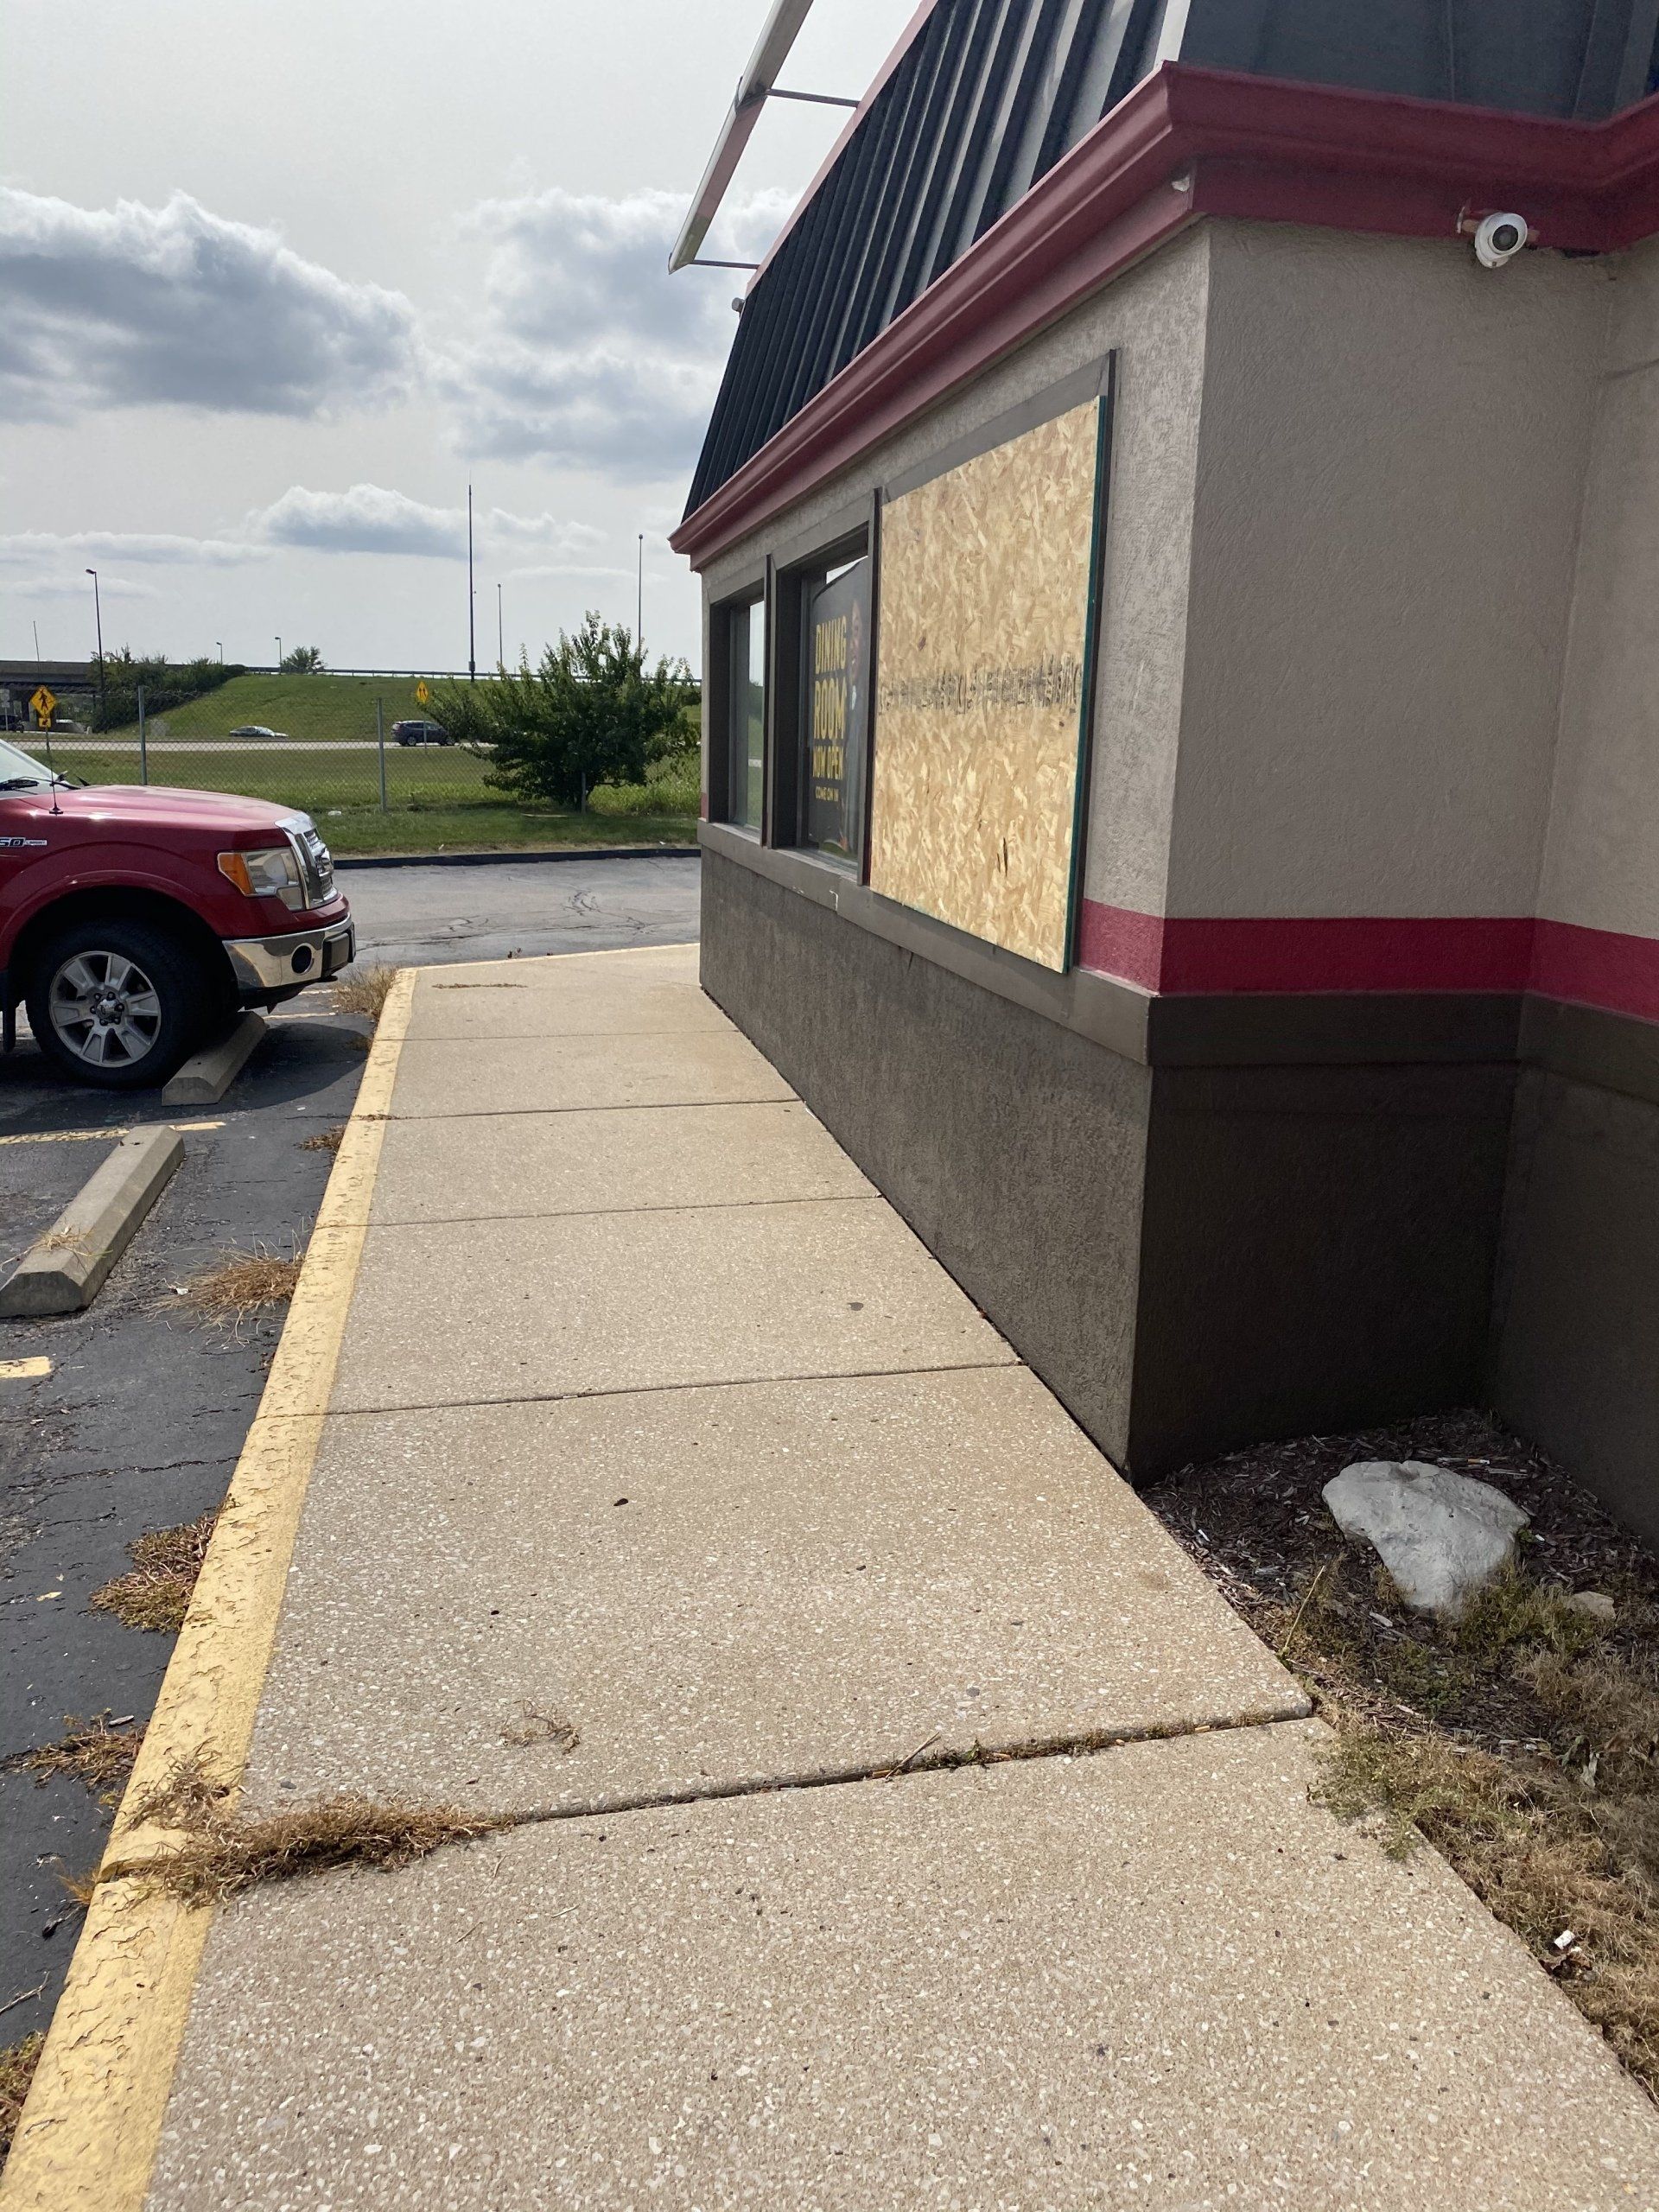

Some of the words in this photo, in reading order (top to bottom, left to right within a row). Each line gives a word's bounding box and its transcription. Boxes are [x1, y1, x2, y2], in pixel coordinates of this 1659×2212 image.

[815, 615, 847, 675] DINING
[814, 677, 847, 740] ROOM
[812, 746, 825, 778] NOW
[827, 746, 843, 780] OPEN
